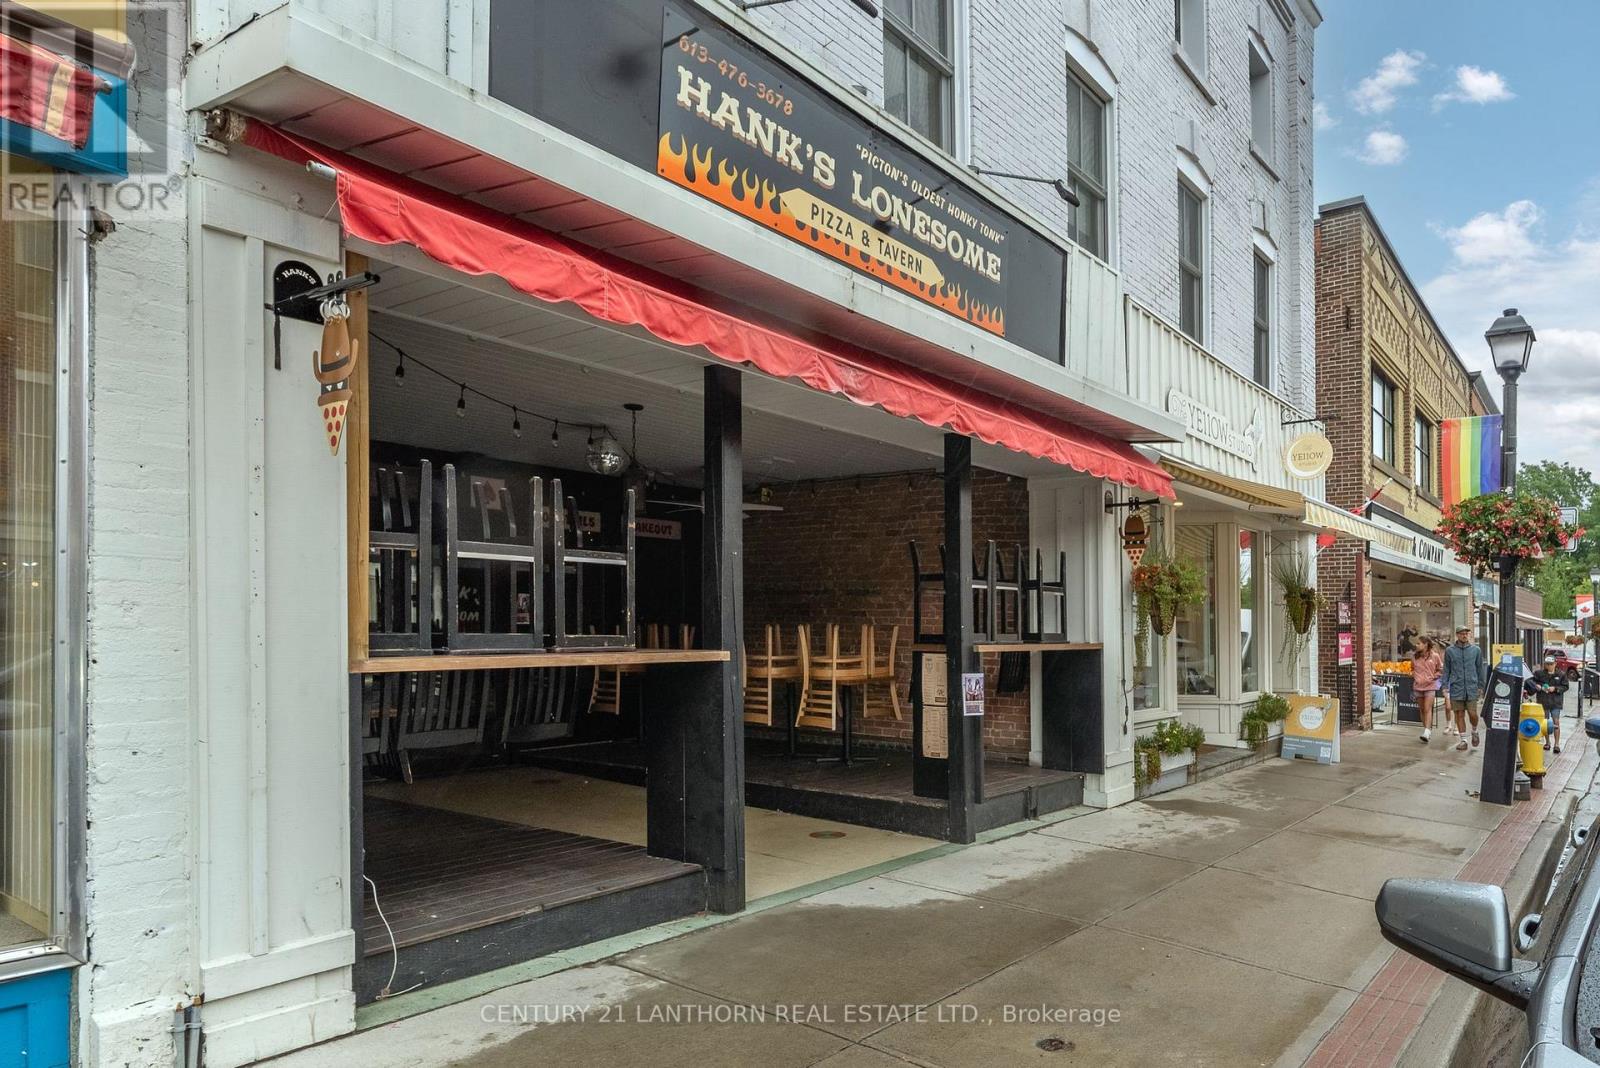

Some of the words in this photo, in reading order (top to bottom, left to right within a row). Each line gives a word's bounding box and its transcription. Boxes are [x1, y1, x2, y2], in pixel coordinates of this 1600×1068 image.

[679, 35, 794, 115] 613-476-3678
[676, 65, 836, 189] HANK'S
[852, 170, 1001, 282] LONESOME
[911, 179, 946, 209] OLDEST
[947, 202, 978, 229] HONKY
[811, 203, 854, 240] PIZZA
[861, 230, 870, 248] &
[878, 238, 923, 275] TAVERN
[281, 268, 317, 285] HANK'S
[1229, 434, 1252, 457] STUDIO
[635, 521, 673, 536] AKEOUT
[1418, 538, 1444, 566] COMPANY
